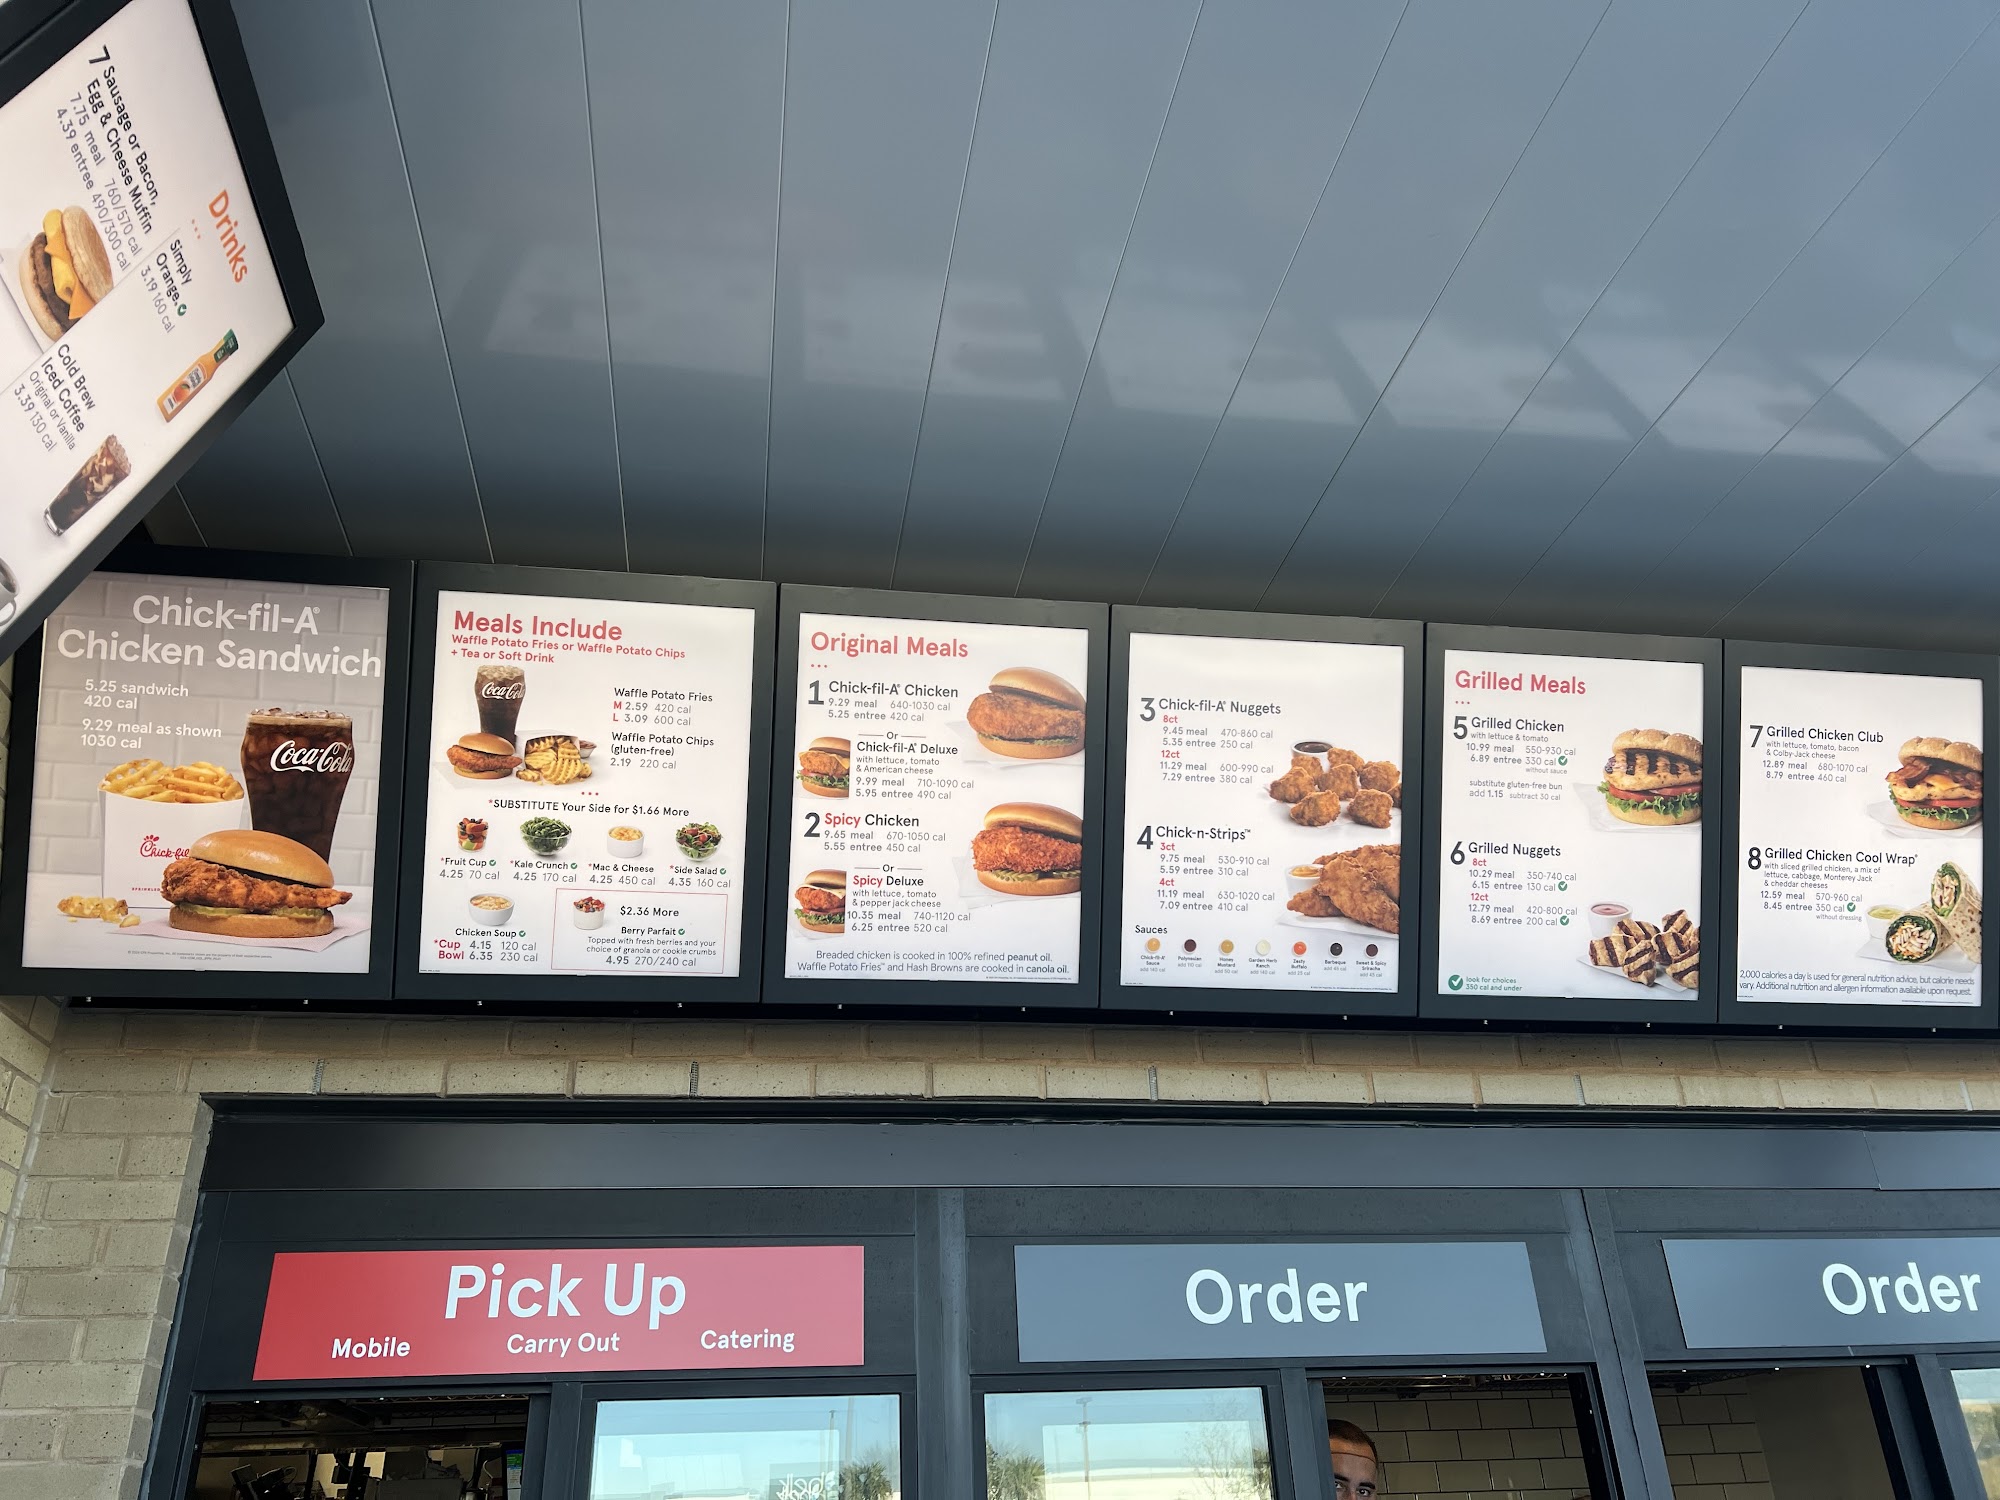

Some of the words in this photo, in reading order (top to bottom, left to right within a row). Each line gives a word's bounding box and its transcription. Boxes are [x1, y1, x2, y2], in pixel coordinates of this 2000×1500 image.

[88, 44, 111, 65] 7
[103, 65, 132, 131] Sausage
[128, 133, 142, 149] or
[135, 151, 158, 205] Bacon,
[87, 77, 103, 113] Egg
[100, 112, 112, 126] &
[106, 127, 133, 186] Cheese
[129, 185, 152, 235] Muffin
[70, 92, 87, 126] 7.75
[84, 131, 105, 166] meal
[103, 178, 134, 234] 760/570
[127, 237, 142, 256] cal
[208, 189, 248, 283] Drinks
[170, 238, 192, 285] Simply
[139, 265, 158, 292] 3.19
[151, 292, 167, 315] 160
[161, 316, 175, 333] cal
[57, 344, 81, 377] Cold
[73, 377, 95, 411] Brew
[41, 357, 61, 390] Iced
[58, 388, 85, 432] Coffee
[29, 370, 53, 410] Original
[49, 408, 60, 420] or
[56, 417, 76, 451] Vanilla
[454, 610, 523, 634] Meals
[532, 616, 622, 642] Include
[58, 629, 204, 666] Chicken
[216, 640, 381, 677] Sandwich
[452, 634, 488, 645] Waffle
[491, 636, 528, 648] Potato
[532, 639, 559, 650] Fries
[562, 643, 574, 651] or
[577, 642, 612, 653] Waffle
[616, 645, 652, 656] Potato
[655, 647, 685, 660] Chips
[461, 648, 480, 658] Tea
[498, 650, 522, 661] Soft
[525, 652, 554, 663] Drink
[811, 632, 898, 657] Original
[907, 636, 968, 657] Meals
[85, 679, 116, 692] 5.25
[121, 683, 188, 697] sandwich
[808, 680, 824, 705] 1
[904, 684, 958, 698] Chicken
[1455, 670, 1522, 691] Grilled
[1531, 674, 1586, 694] Meals
[84, 695, 112, 707] 420
[116, 697, 137, 709] cal
[614, 687, 648, 698] Waffle
[651, 689, 685, 700] Potato
[688, 692, 713, 702] Fries
[828, 697, 850, 707] 9.29
[854, 700, 877, 708] meal
[890, 700, 934, 710] 640-1030
[937, 703, 950, 711] cal
[613, 701, 622, 710] M
[625, 701, 648, 711] 2.59
[655, 703, 674, 713] 420
[677, 705, 691, 714] cal
[1140, 697, 1156, 722] 3
[1230, 701, 1281, 717] Nuggets
[1163, 714, 1178, 723] 8ct
[82, 718, 113, 731] 9.29
[117, 722, 152, 734] meal
[156, 725, 171, 735] as
[175, 724, 221, 738] shown
[613, 713, 619, 722] L
[624, 713, 648, 723] 3.09
[654, 715, 674, 725] 600
[676, 717, 691, 726] cal
[1453, 716, 1468, 740] 5
[1471, 716, 1511, 729] Grilled
[1515, 719, 1564, 732] Chicken
[81, 734, 116, 747] 1030
[121, 737, 142, 749] cal
[1163, 726, 1183, 735] 9.45
[1186, 728, 1208, 736] meal
[1220, 728, 1258, 738] 470-860
[1260, 730, 1273, 739] cal
[1750, 725, 1763, 748] 7
[1767, 726, 1804, 738] Grilled
[1808, 728, 1854, 741] Chicken
[1857, 731, 1884, 743] Club
[1466, 743, 1490, 752] 10.99
[1494, 745, 1514, 753] meal
[1526, 745, 1562, 755] 550-930
[1564, 746, 1576, 756] cal
[1763, 760, 1785, 768] 12.89
[1818, 762, 1854, 772] 680-1070
[1856, 765, 1868, 773] cal
[562, 802, 586, 812] Your
[588, 803, 611, 813] Side
[614, 804, 630, 814] for
[632, 804, 660, 815] $1.66
[663, 807, 689, 817] More
[804, 812, 820, 837] 2
[824, 812, 861, 828] Spicy
[865, 814, 919, 827] Chicken
[1137, 825, 1153, 850] 4
[1450, 841, 1465, 865] 6
[1468, 842, 1508, 854] Grilled
[1513, 843, 1561, 859] Nuggets
[1472, 858, 1487, 867] 8ct
[1748, 847, 1762, 870] 8
[1765, 847, 1802, 860] Grilled
[1806, 849, 1852, 862] Chicken
[1856, 851, 1882, 863] Cool
[535, 861, 568, 869] Crunch
[513, 872, 537, 881] 4.25
[543, 873, 559, 882] 170
[562, 874, 577, 883] cal
[620, 905, 649, 916] $2.36
[653, 907, 679, 917] More
[455, 928, 492, 937] Chicken
[494, 929, 517, 939] Soup
[1135, 924, 1168, 934] Sauces
[438, 950, 464, 960] Bowl
[469, 951, 493, 961] 6.35
[500, 952, 520, 962] 230
[523, 953, 538, 962] cal
[816, 950, 854, 959] Breaded
[856, 951, 891, 960] chicken
[893, 951, 900, 960] is
[902, 951, 935, 960] cooked
[937, 951, 945, 960] in
[948, 951, 972, 961] 100%
[974, 952, 1005, 961] refined
[1007, 953, 1038, 963] peanut
[1040, 953, 1052, 961] oil.
[445, 1263, 583, 1319] Pick
[604, 1263, 686, 1330] Up
[1186, 1268, 1367, 1324] Order
[1822, 1262, 1981, 1315] Order
[332, 1336, 410, 1358] Mobile
[507, 1334, 572, 1358] Carry
[578, 1332, 620, 1352] Out
[701, 1328, 795, 1353] Catering
